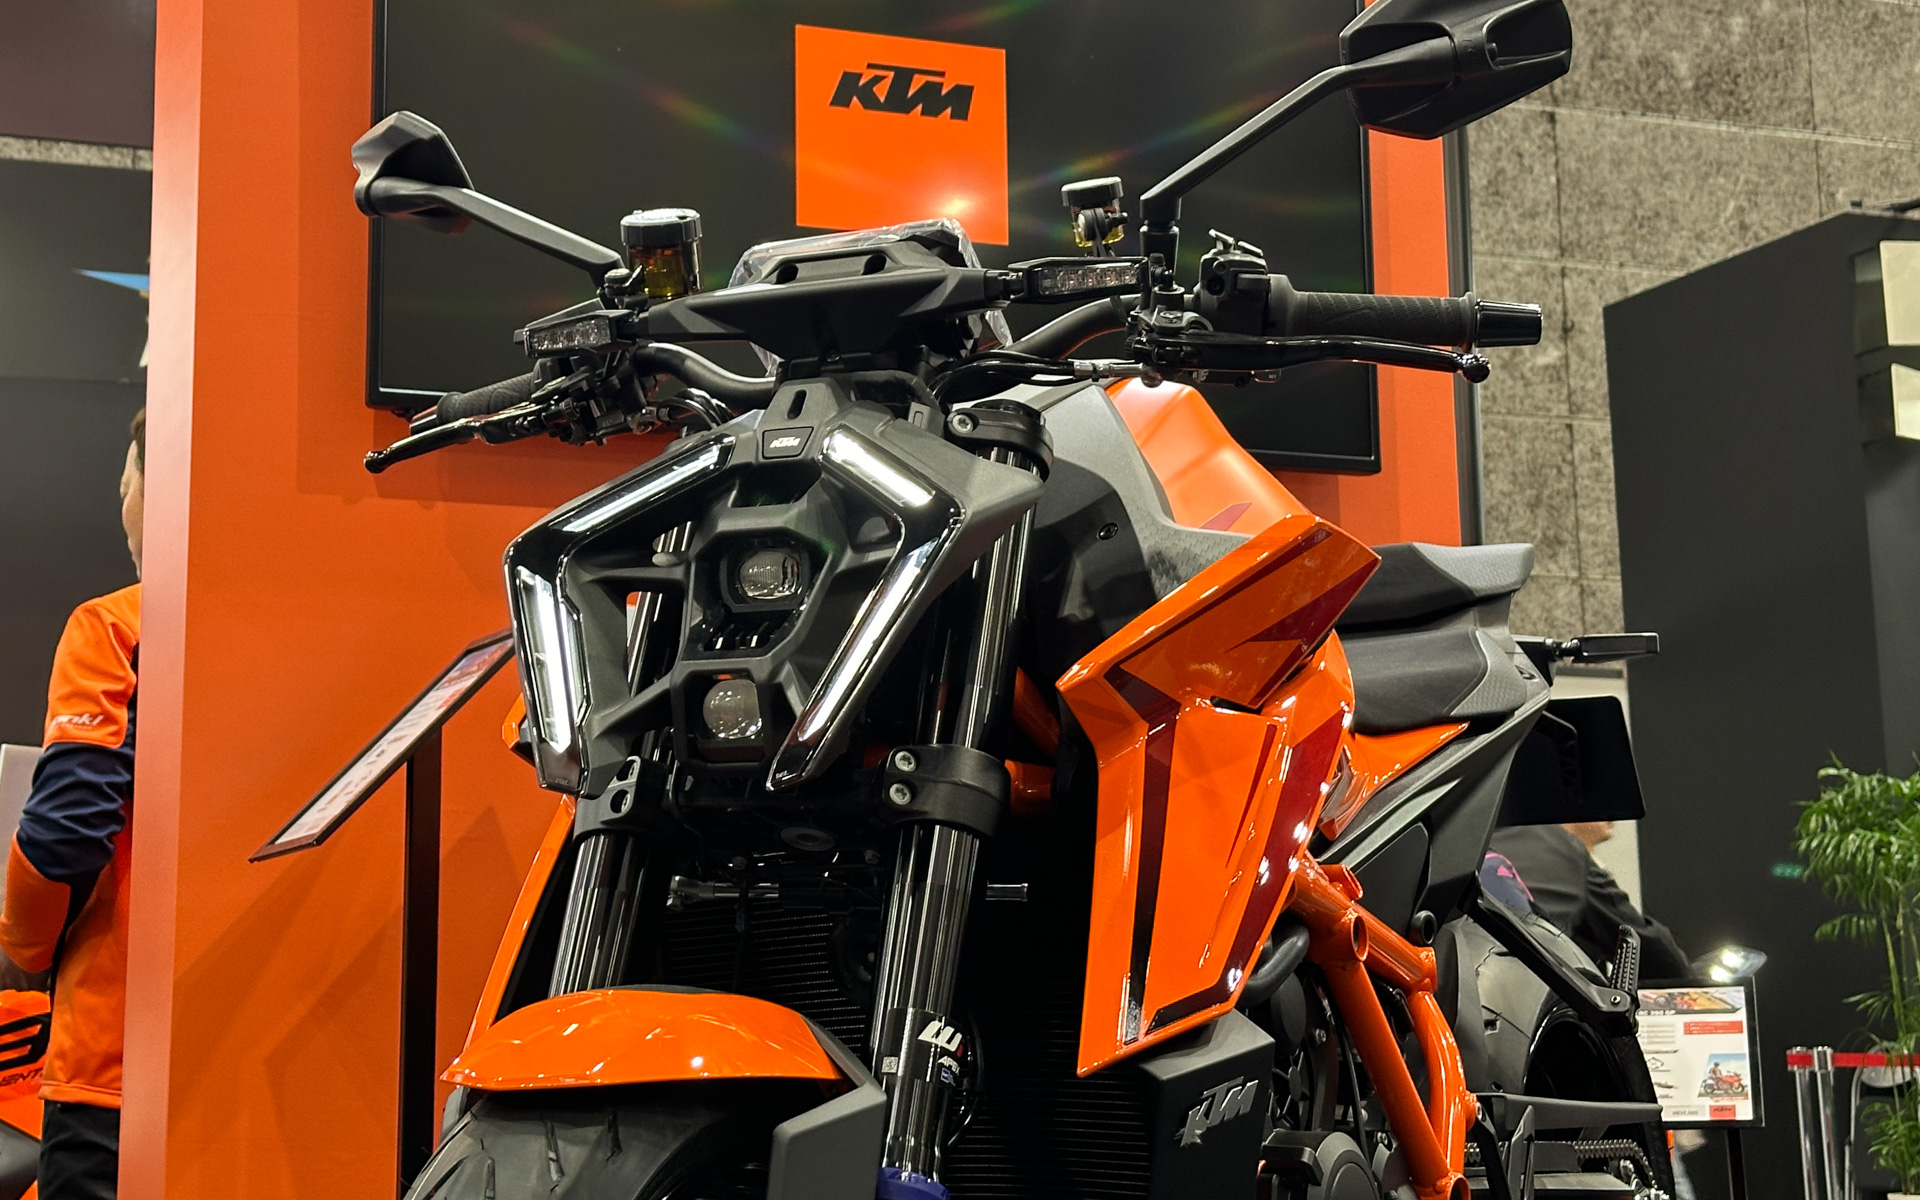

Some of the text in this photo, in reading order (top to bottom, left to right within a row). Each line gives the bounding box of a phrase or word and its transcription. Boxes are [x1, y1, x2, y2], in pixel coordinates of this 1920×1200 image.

[829, 62, 975, 122] KTM
[769, 436, 801, 449] KTM
[1174, 1076, 1259, 1148] KTM
